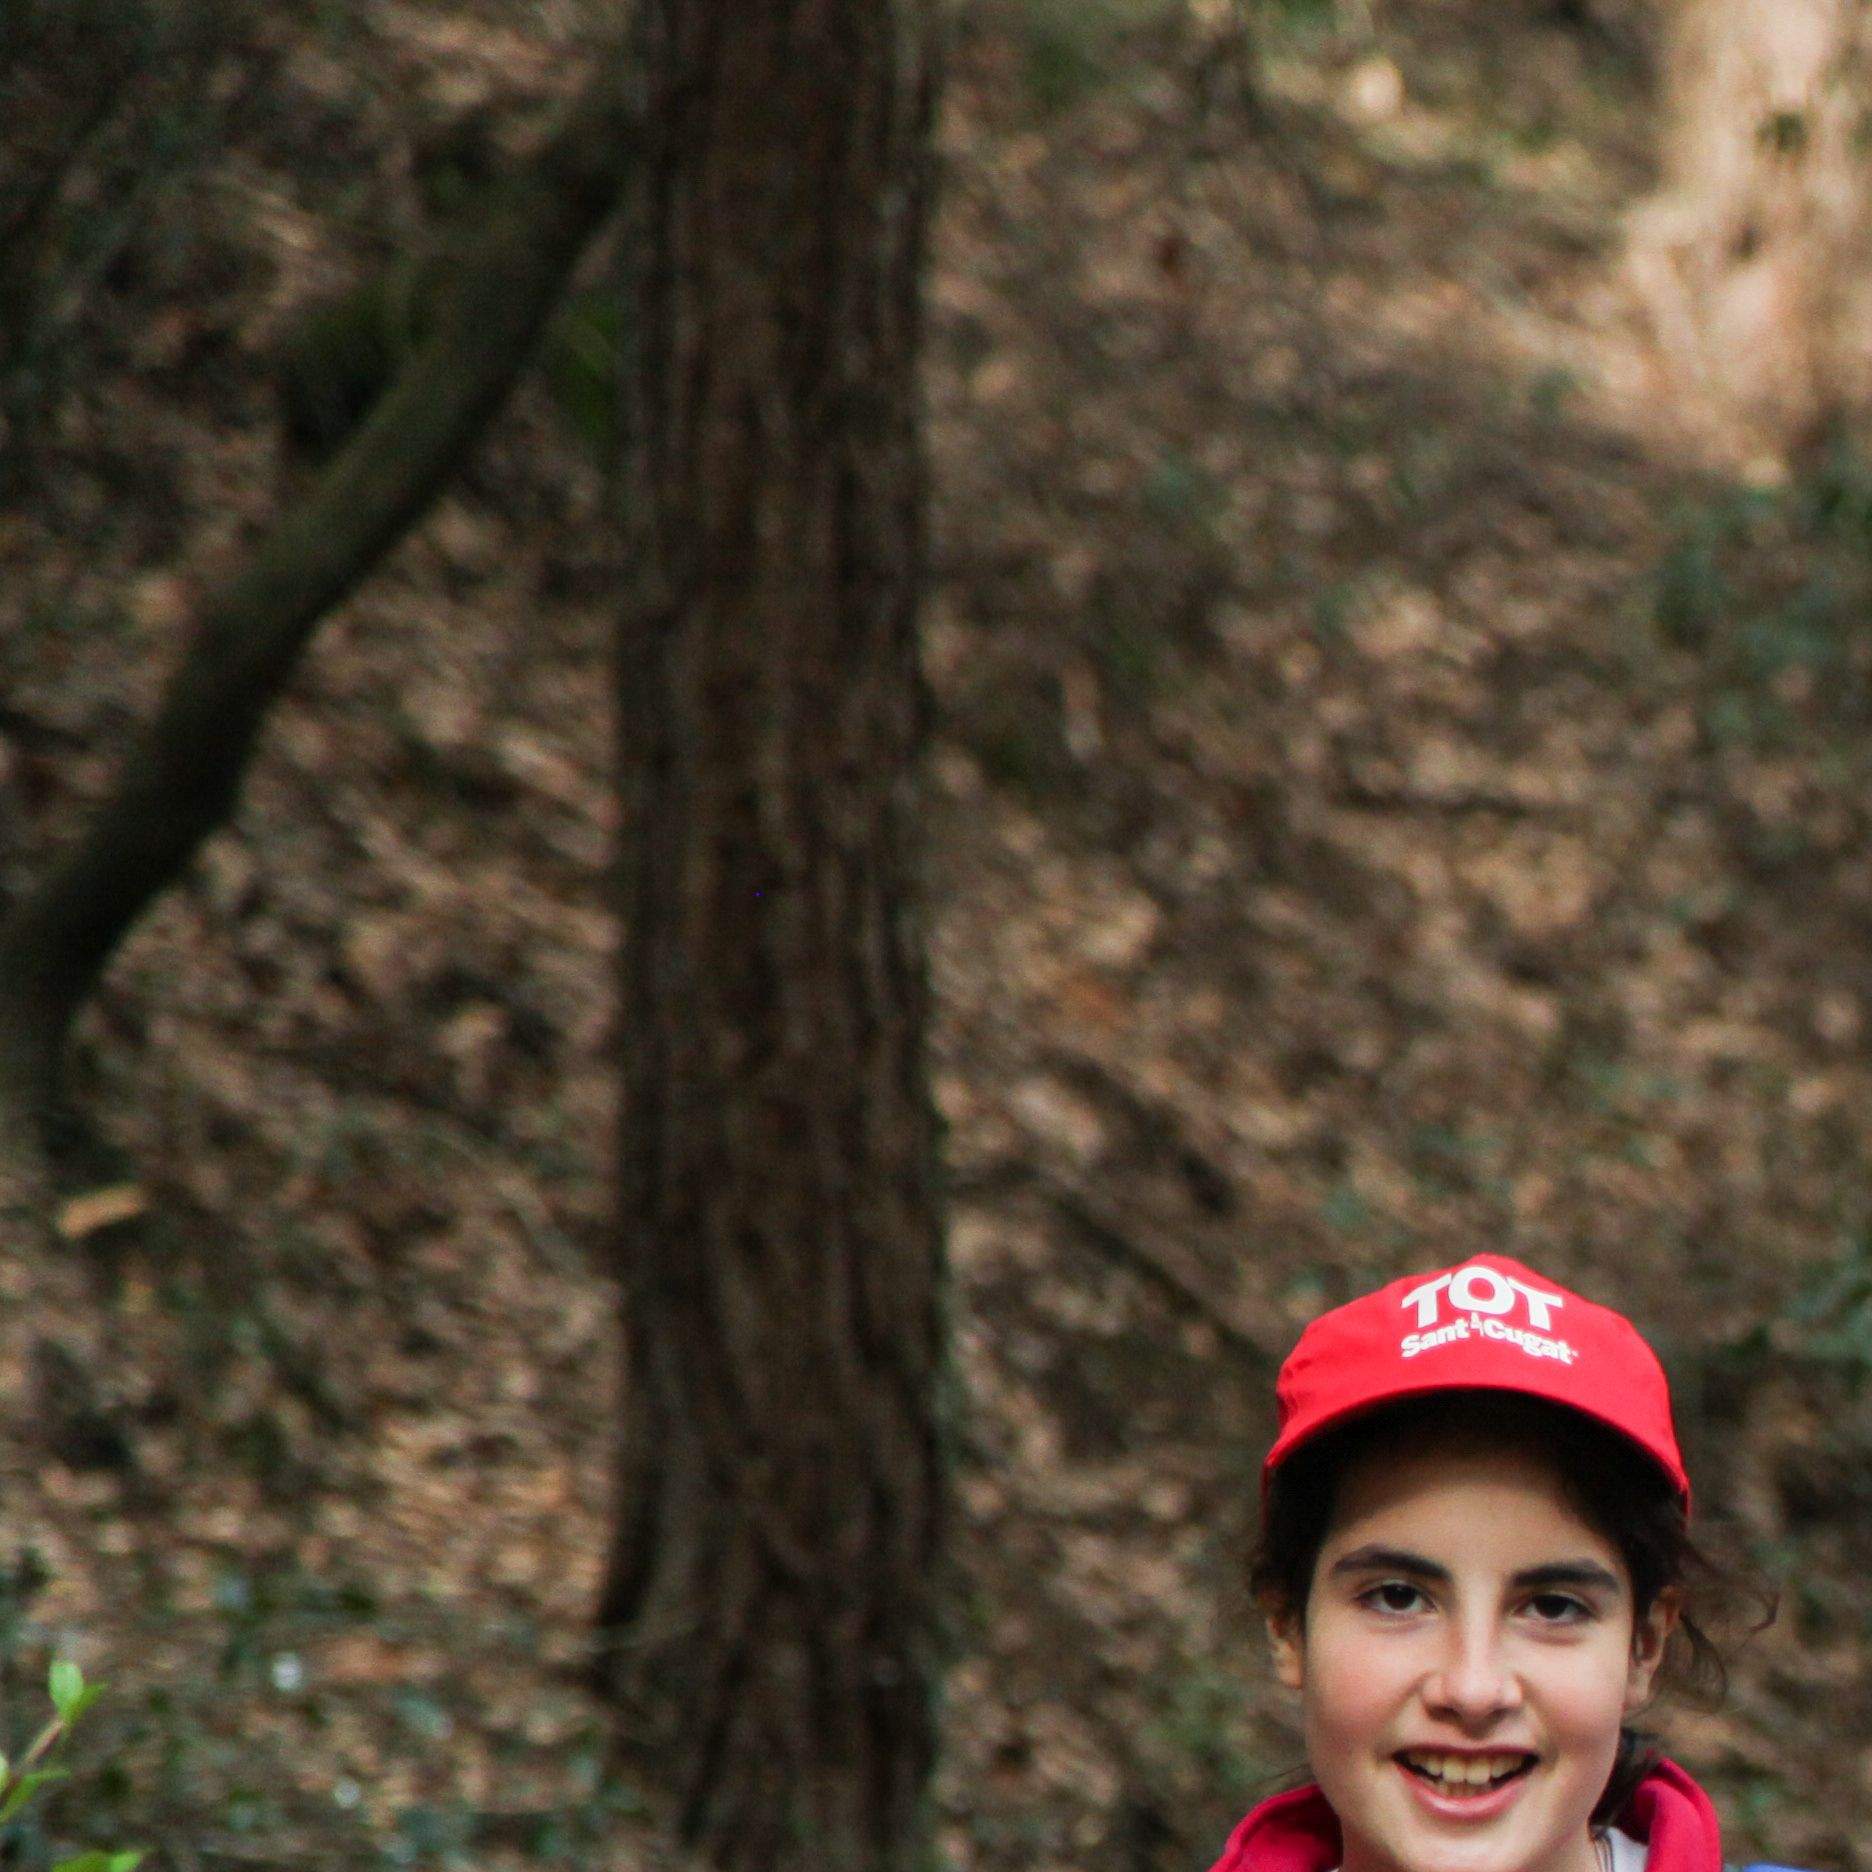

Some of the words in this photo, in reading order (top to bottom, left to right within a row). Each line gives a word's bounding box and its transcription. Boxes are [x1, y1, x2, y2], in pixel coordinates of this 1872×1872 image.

[1401, 1266, 1564, 1331] TOT
[1400, 1318, 1471, 1359] Sant
[1483, 1318, 1574, 1370] Cugat
